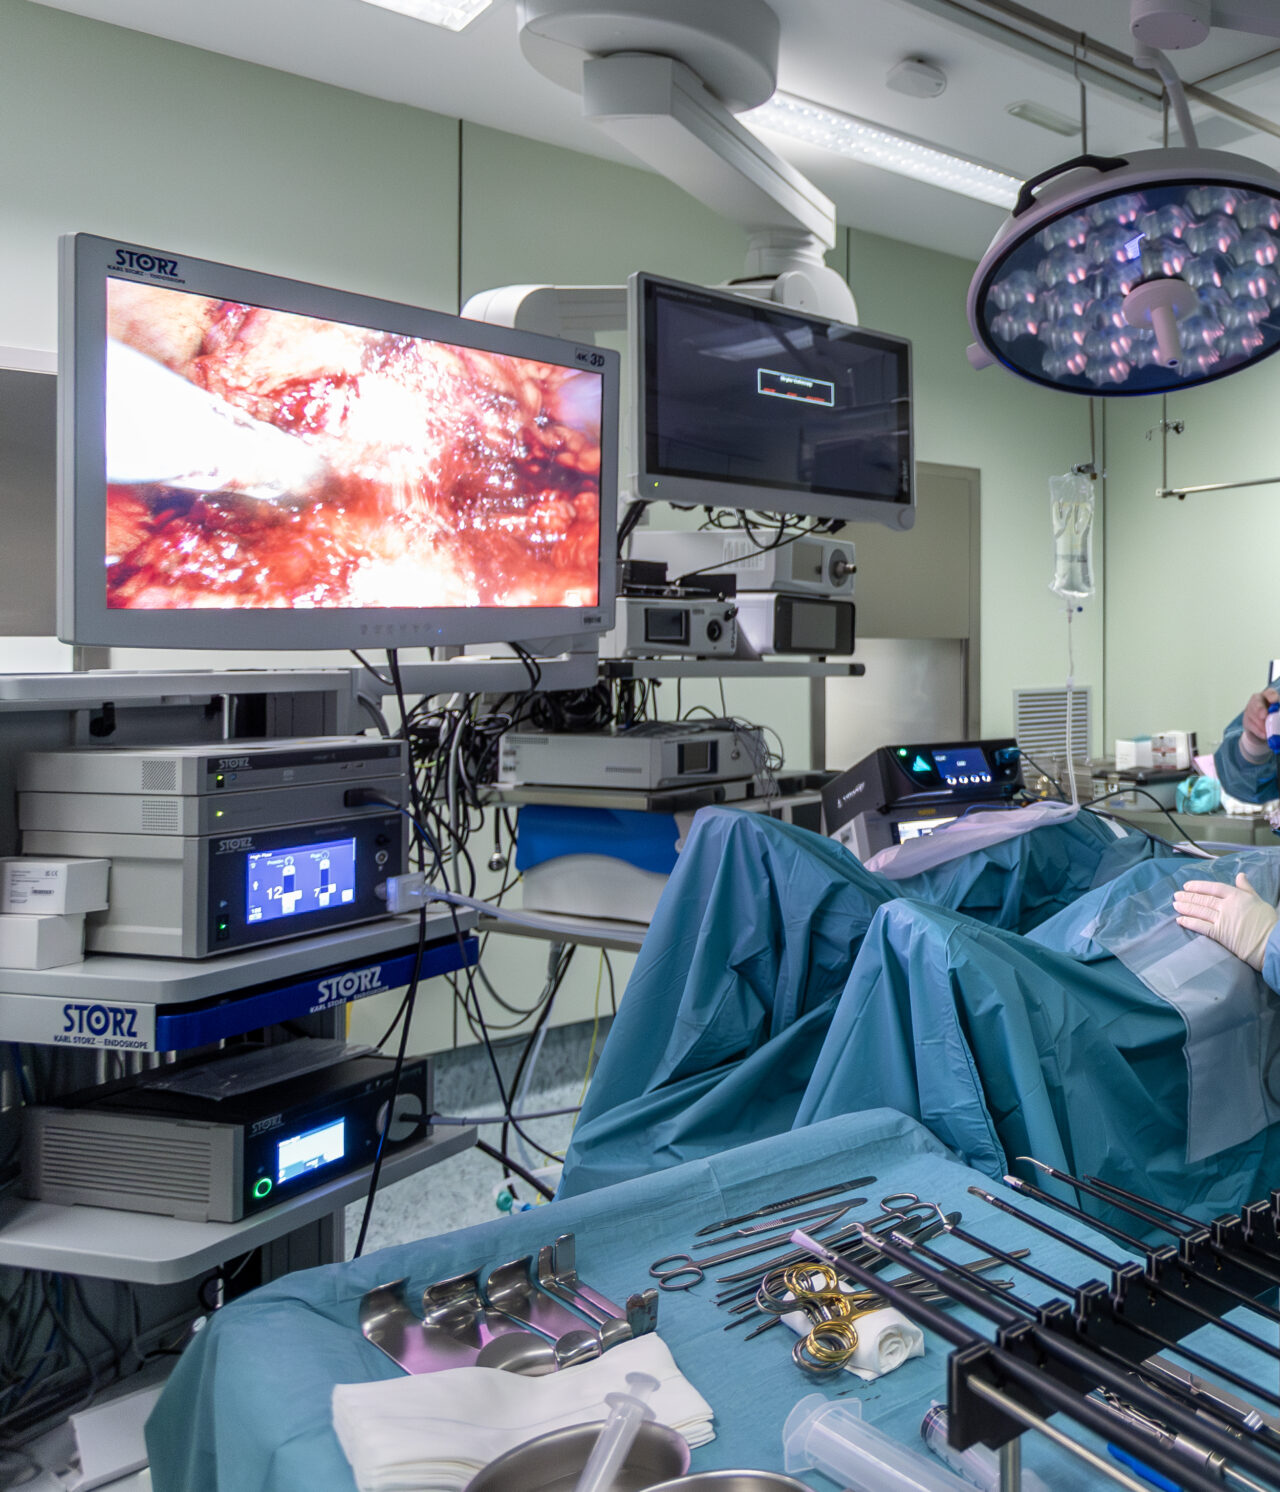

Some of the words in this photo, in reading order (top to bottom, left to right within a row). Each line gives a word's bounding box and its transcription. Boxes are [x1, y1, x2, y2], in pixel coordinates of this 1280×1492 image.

[115, 248, 178, 277] STORZ
[590, 352, 605, 367] 3D
[218, 757, 249, 769] STORZ
[219, 837, 252, 850] STORZ
[266, 885, 284, 901] 12
[318, 966, 382, 1004] STORZ
[63, 1004, 138, 1038] STORZ
[54, 1035, 72, 1043] KARL
[73, 1036, 96, 1045] STORZ
[104, 1038, 148, 1050] ENDOSKOPE
[252, 1113, 283, 1134] STORZ
